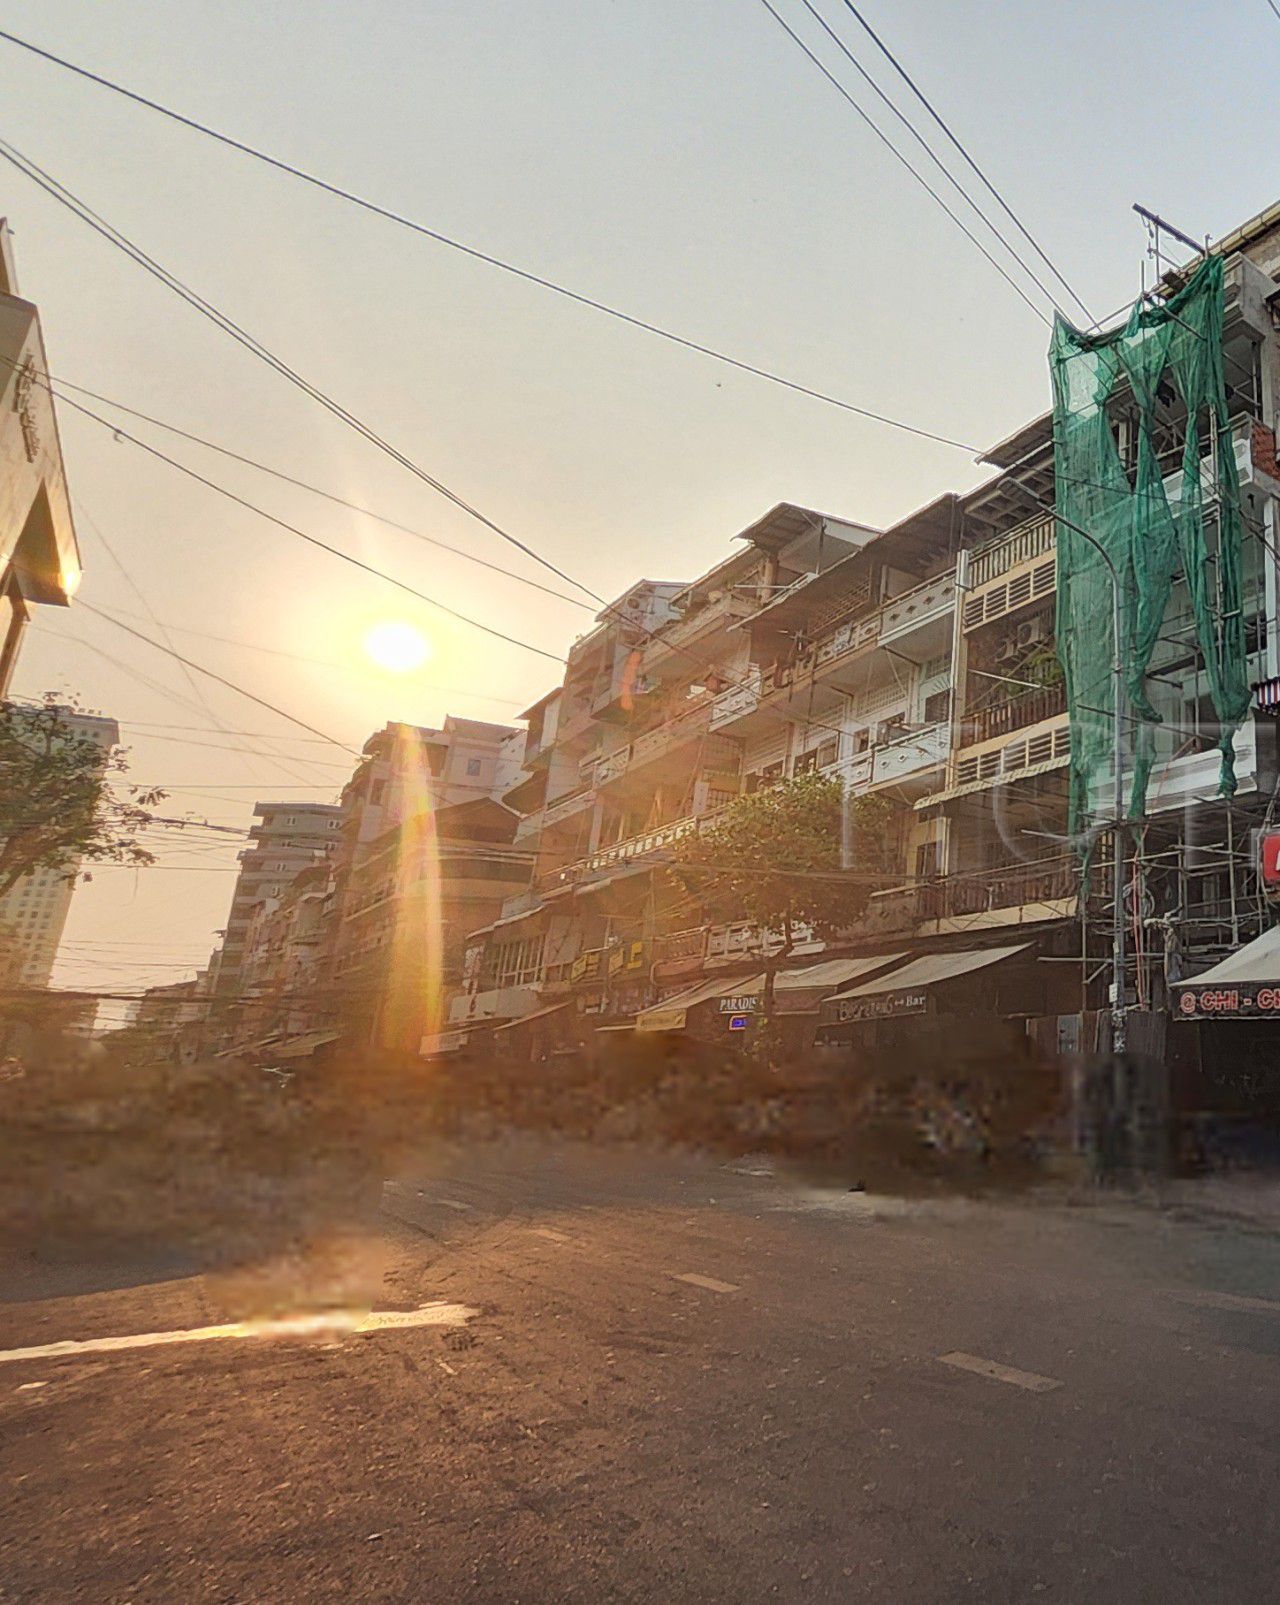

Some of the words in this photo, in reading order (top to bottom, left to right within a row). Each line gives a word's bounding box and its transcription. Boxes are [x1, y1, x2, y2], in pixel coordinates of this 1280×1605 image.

[906, 995, 926, 1007] Bar
[1180, 992, 1196, 1013] @
[1200, 990, 1238, 1010] CHI
